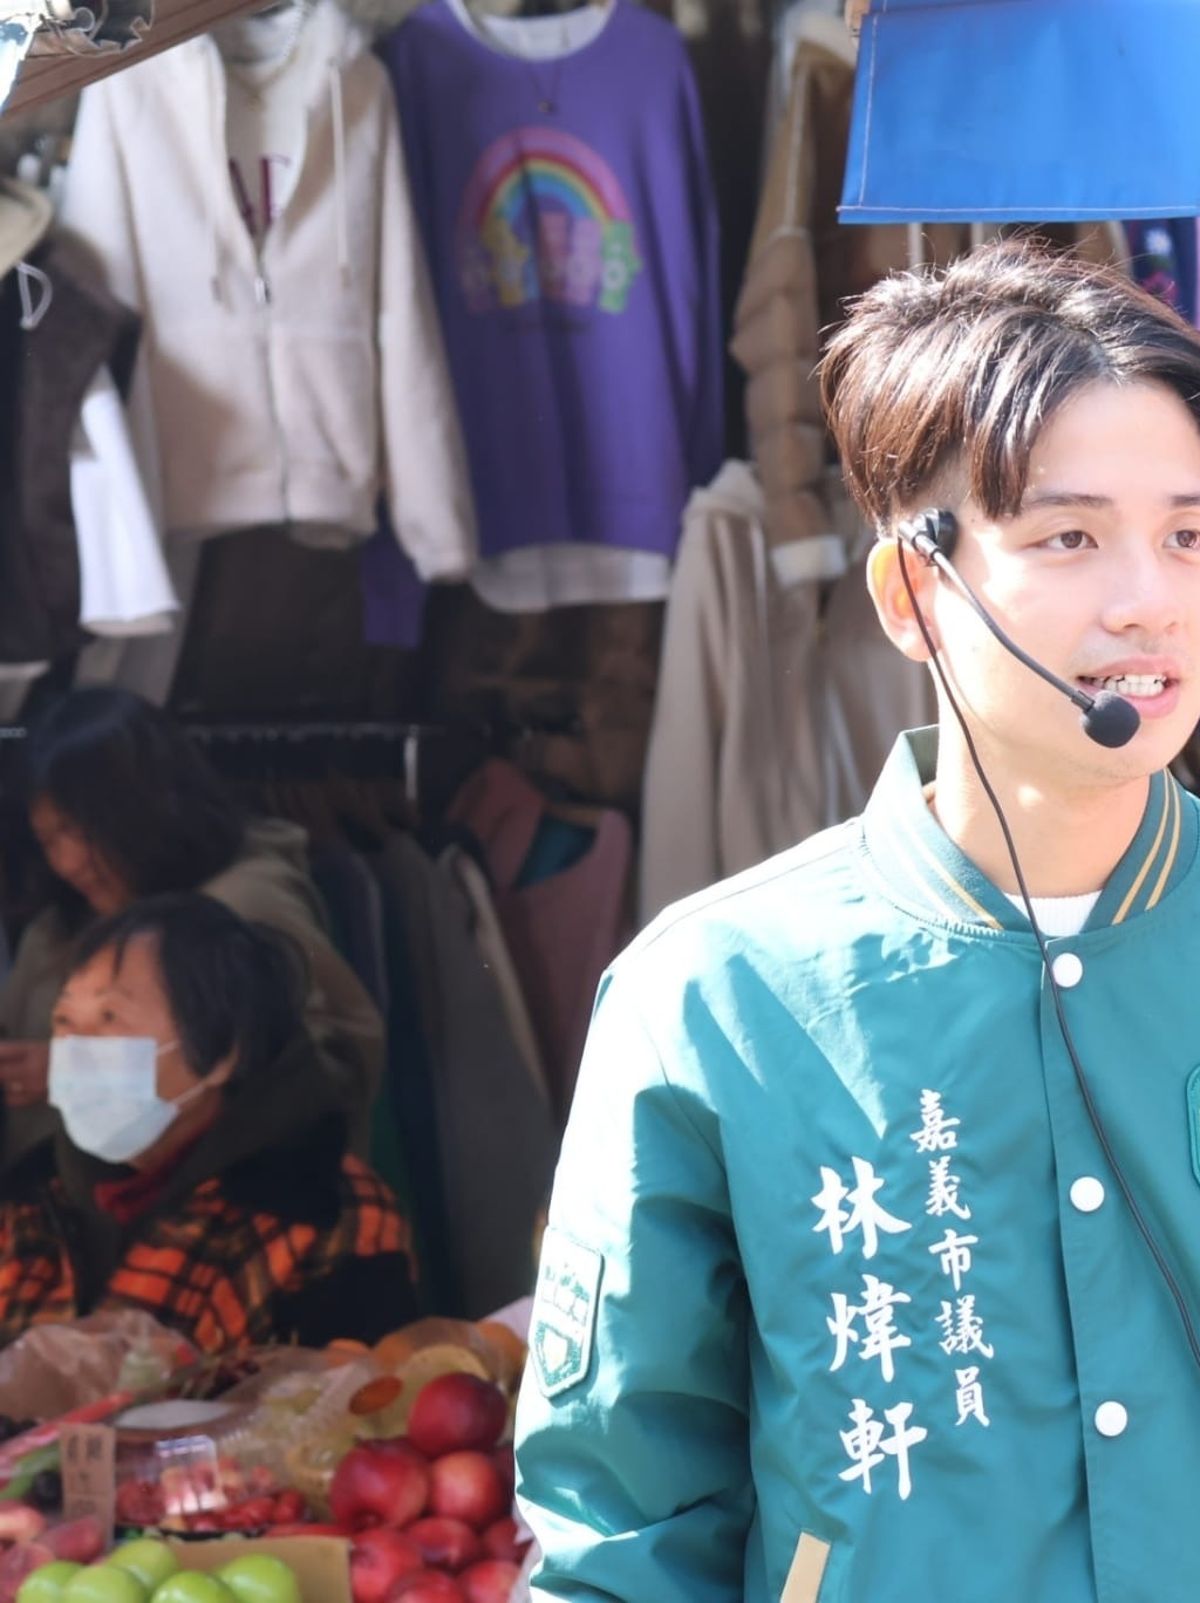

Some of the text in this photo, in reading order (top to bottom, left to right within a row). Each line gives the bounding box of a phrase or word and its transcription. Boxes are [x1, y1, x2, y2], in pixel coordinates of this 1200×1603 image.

[811, 1156, 928, 1500] 林煒軒
[910, 1089, 994, 1427] 嘉義市議員
